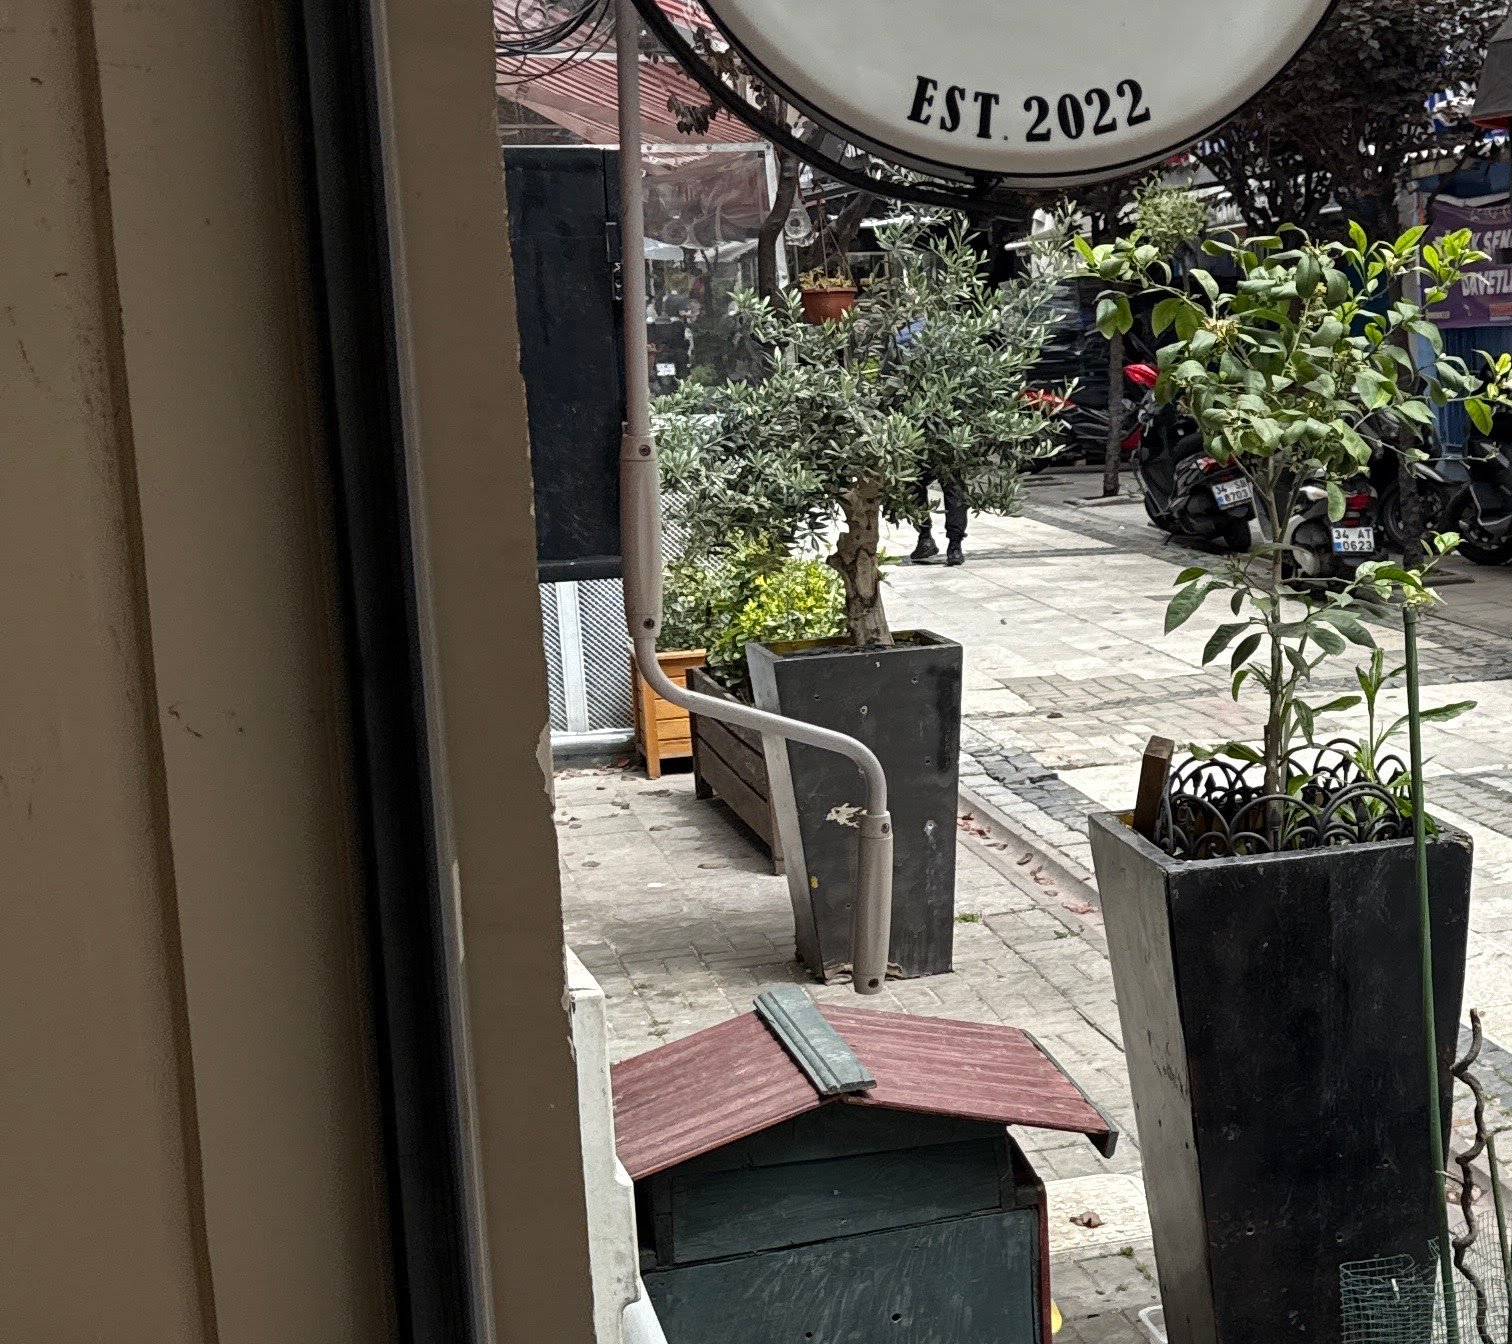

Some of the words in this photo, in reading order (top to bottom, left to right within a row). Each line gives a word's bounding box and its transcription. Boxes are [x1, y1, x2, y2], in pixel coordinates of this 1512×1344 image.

[907, 75, 1009, 141] EST.
[1023, 78, 1152, 142] 2022
[1334, 529, 1350, 540] 34
[1357, 528, 1372, 540] AT
[1342, 540, 1373, 552] 0623
